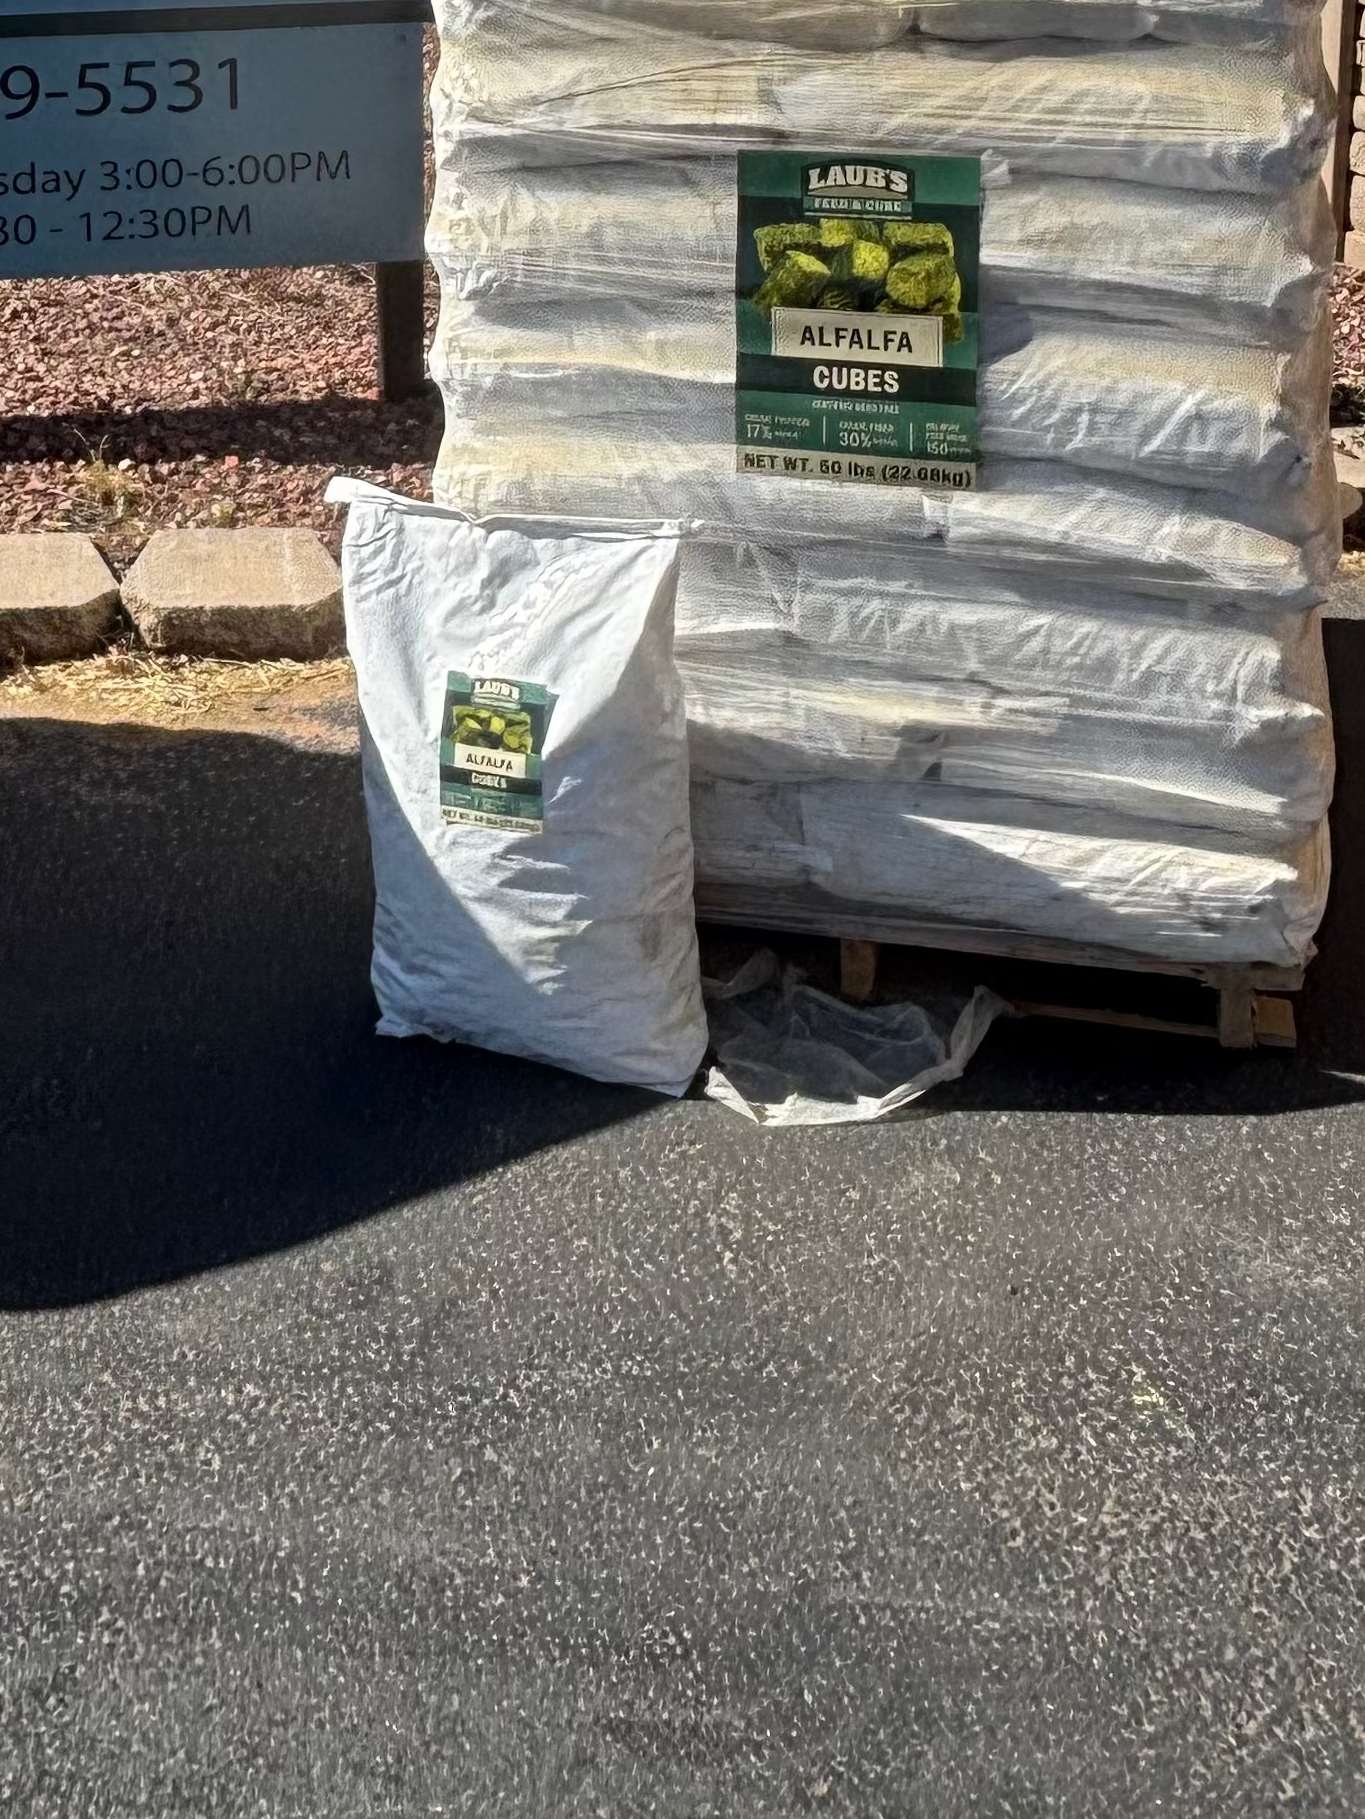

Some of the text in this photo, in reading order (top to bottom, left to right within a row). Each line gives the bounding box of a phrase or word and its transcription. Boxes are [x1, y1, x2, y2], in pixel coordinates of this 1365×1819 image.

[99, 149, 351, 192] 3:00-6:00PM
[808, 165, 908, 194] LAUB'S
[78, 203, 252, 243] 12:30PM
[799, 324, 913, 354] ALFALFA
[812, 364, 900, 393] CUBES
[743, 452, 778, 471] NET
